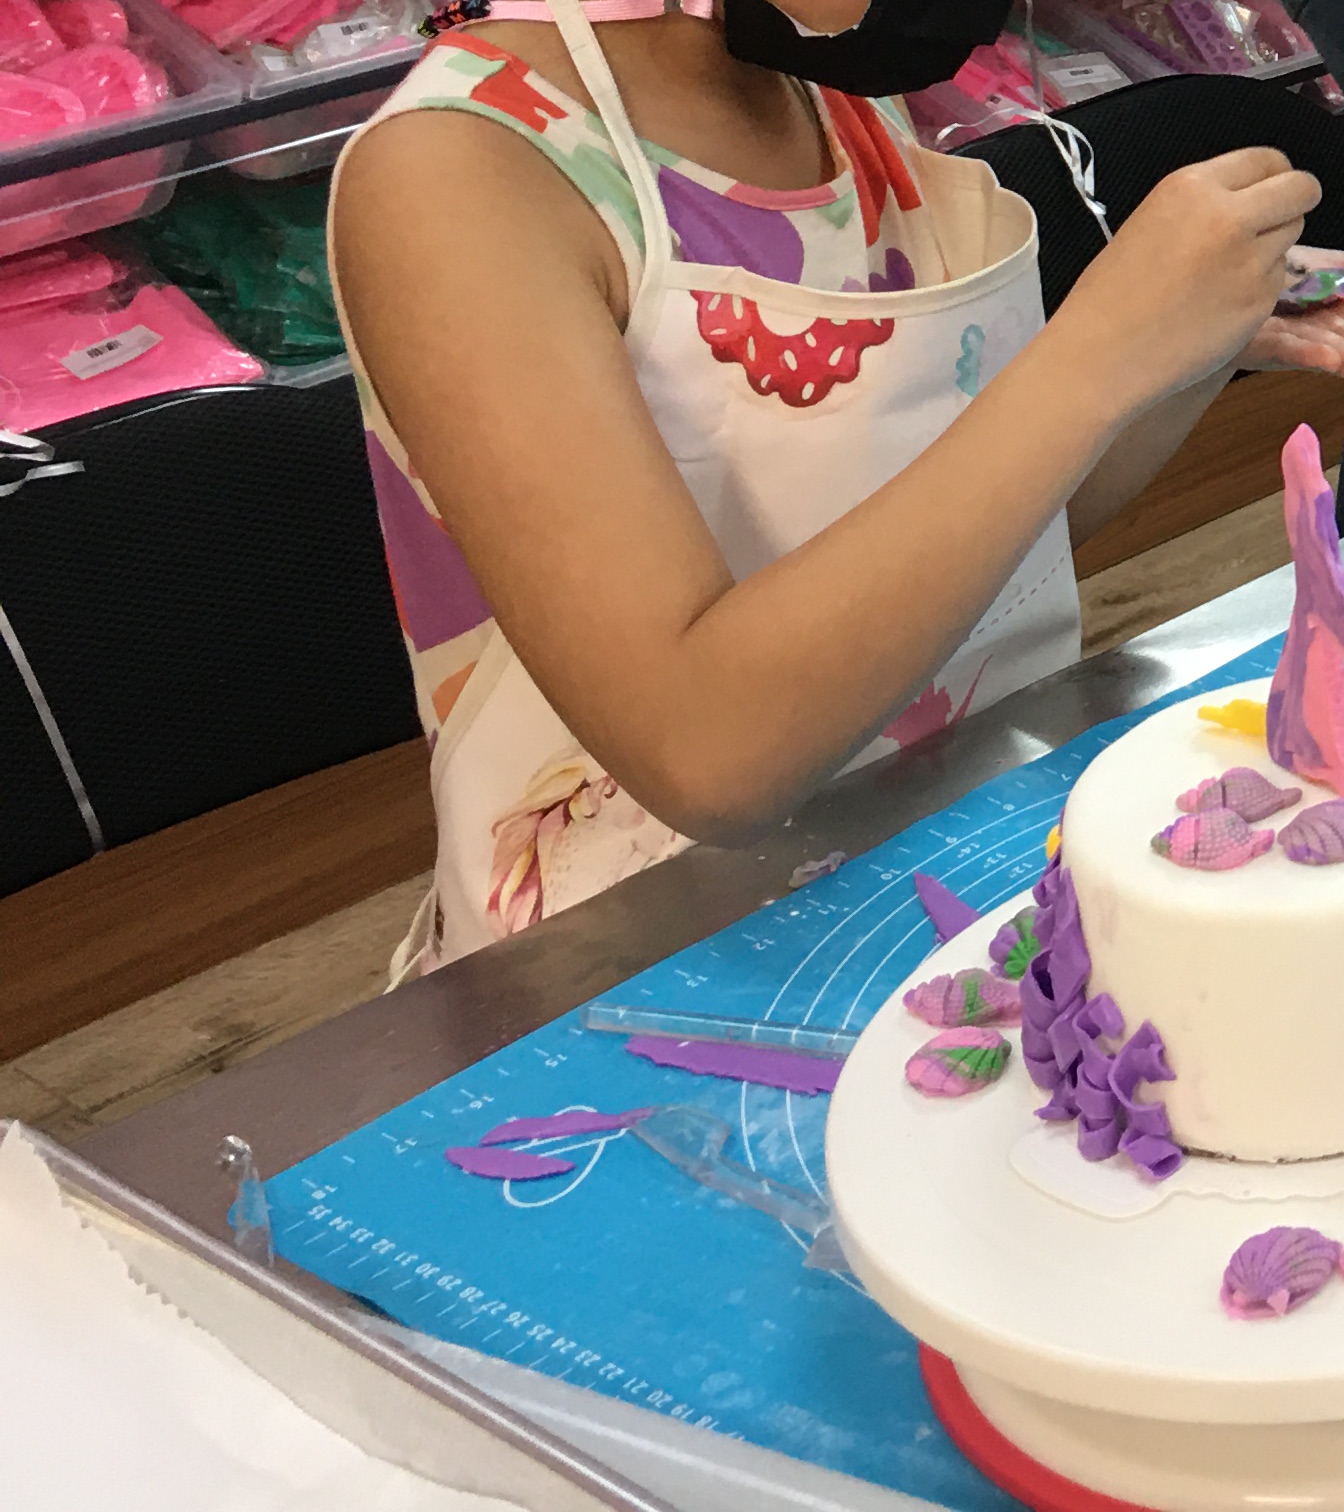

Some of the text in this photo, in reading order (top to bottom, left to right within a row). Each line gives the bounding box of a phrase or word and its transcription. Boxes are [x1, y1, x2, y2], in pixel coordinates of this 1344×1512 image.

[469, 1096, 495, 1110] 16
[395, 1138, 418, 1155] 17
[307, 1204, 333, 1220] 35
[328, 1216, 353, 1231] 34
[350, 1228, 375, 1243] 33
[371, 1238, 396, 1254] 32
[393, 1251, 418, 1266] 31
[415, 1263, 440, 1278] 30
[437, 1275, 462, 1291] 29
[459, 1286, 485, 1302] 28
[480, 1300, 507, 1315] 27
[504, 1311, 531, 1327] 26
[526, 1324, 554, 1341] 25
[551, 1337, 577, 1354] 24
[574, 1349, 601, 1367] 23
[598, 1362, 625, 1380] 22
[622, 1377, 649, 1394] 21
[646, 1389, 673, 1408] 20
[670, 1403, 695, 1420] 19
